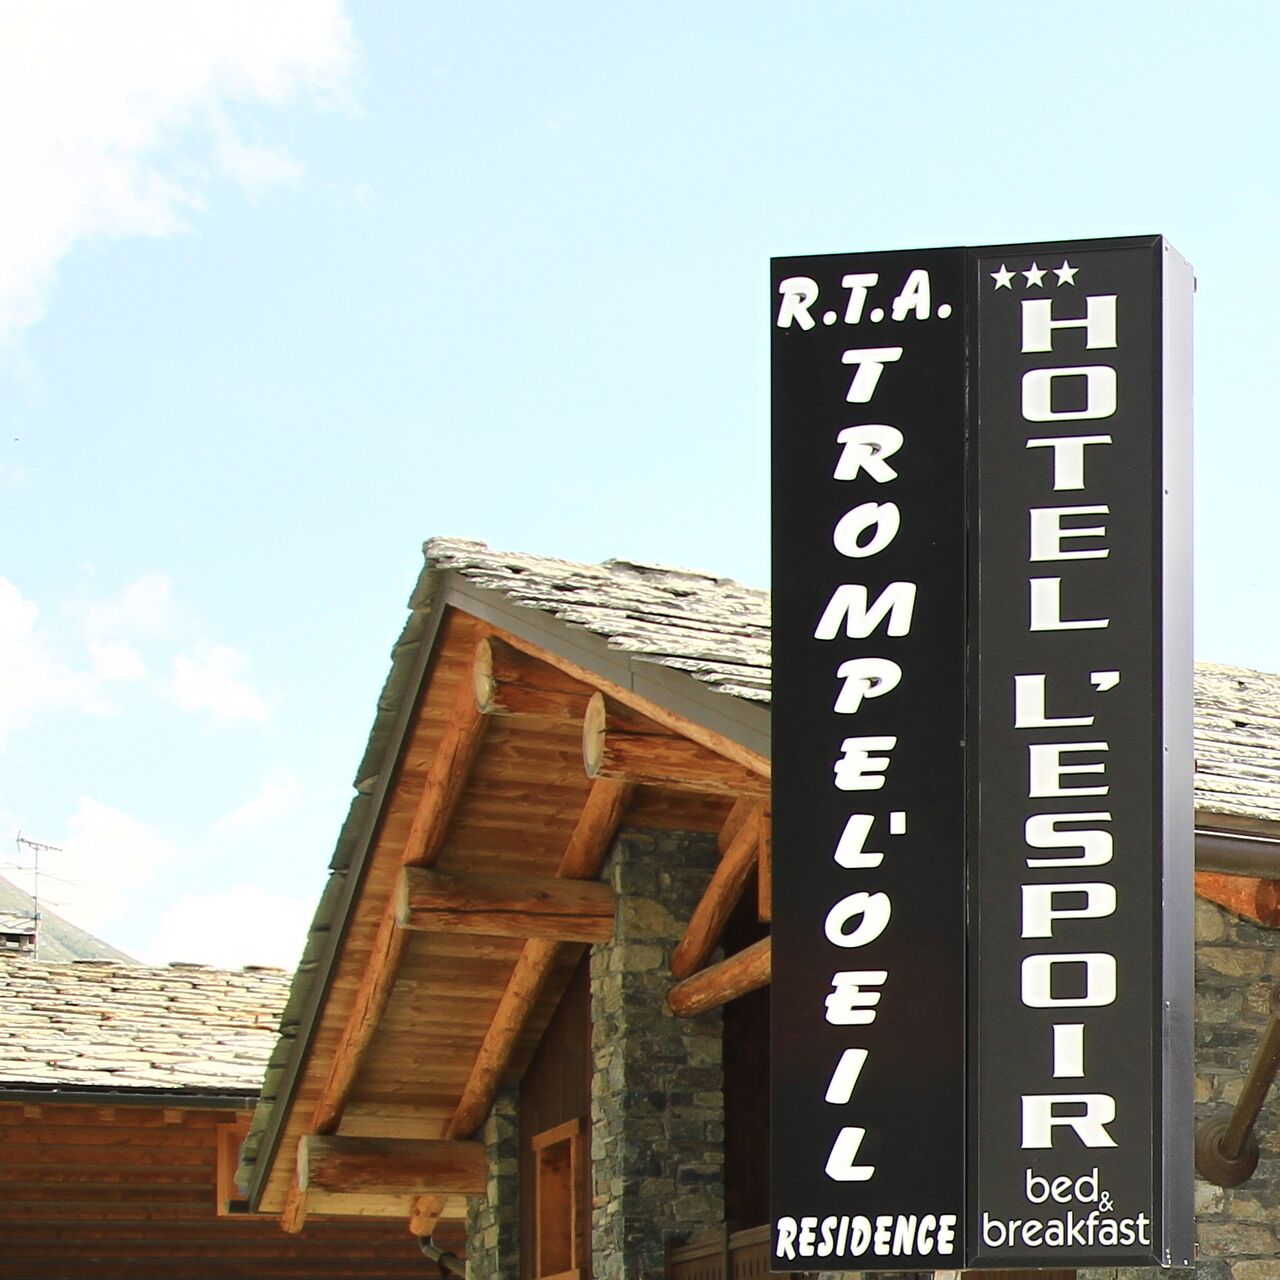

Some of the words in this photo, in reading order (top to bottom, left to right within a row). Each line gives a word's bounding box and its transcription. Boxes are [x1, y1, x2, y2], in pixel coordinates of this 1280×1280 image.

[776, 269, 952, 331] R.T.A.
[1021, 294, 1118, 632] HOTEL
[1014, 671, 1120, 1149] L'ESPOIR
[1026, 1167, 1099, 1203] bed
[775, 1214, 957, 1261] RESIDENCE
[982, 1210, 1151, 1247] breakfast
